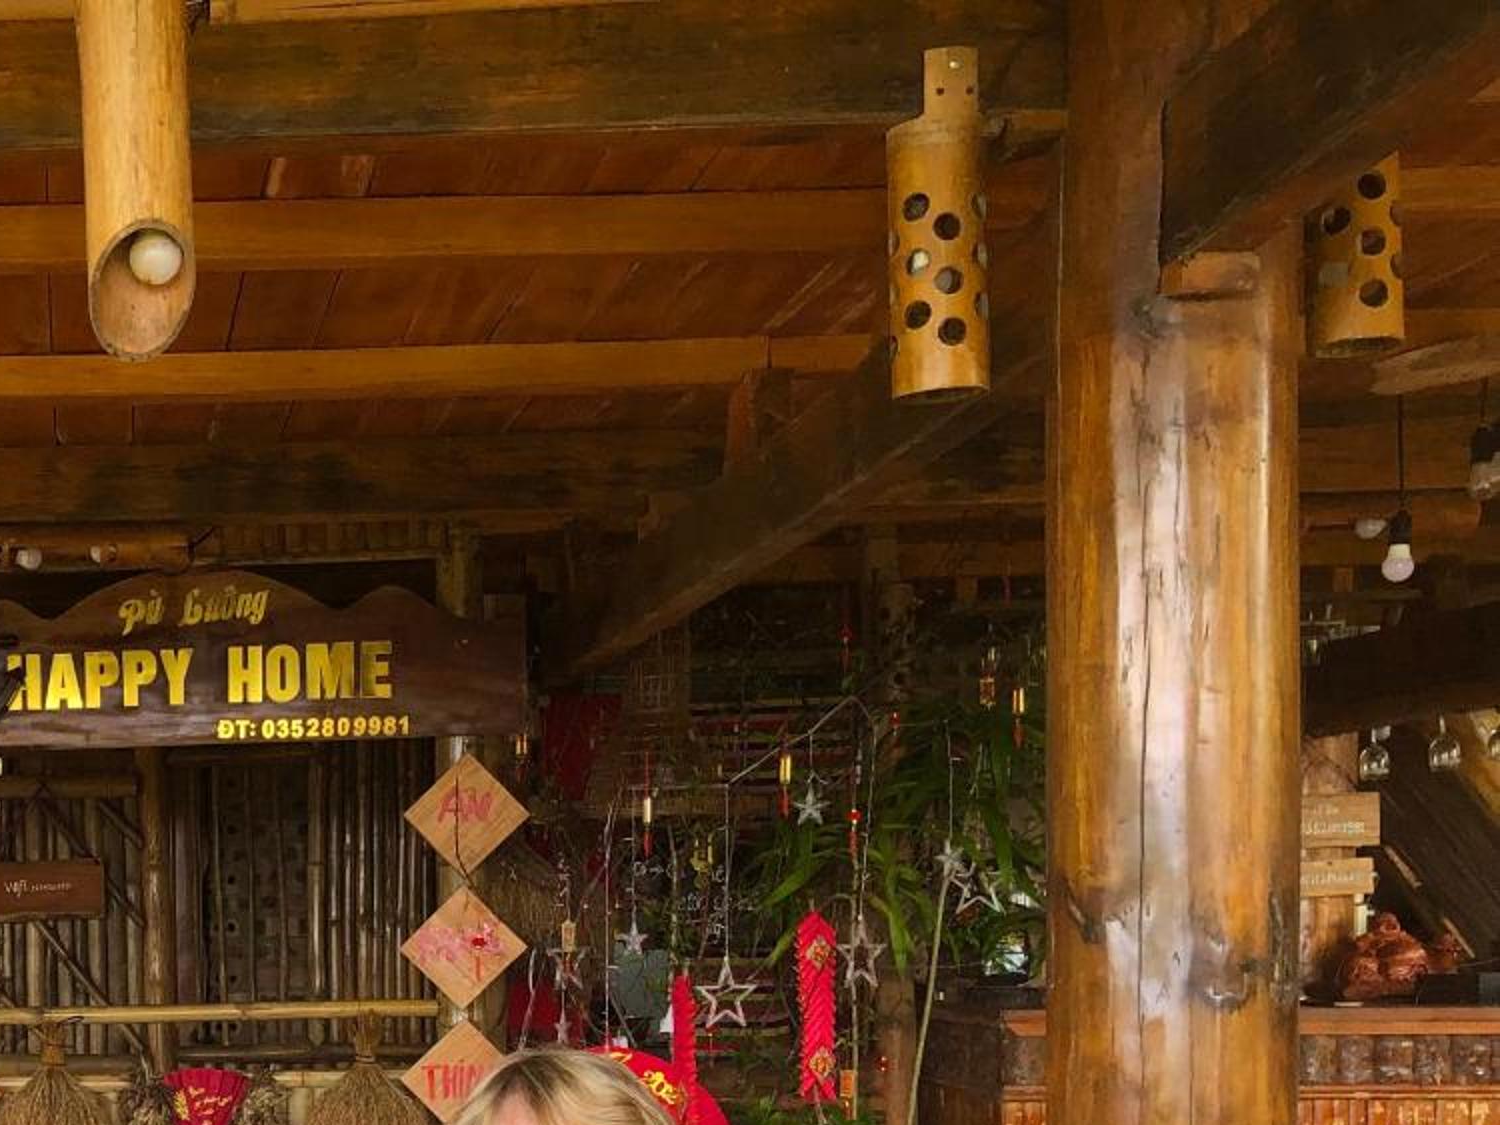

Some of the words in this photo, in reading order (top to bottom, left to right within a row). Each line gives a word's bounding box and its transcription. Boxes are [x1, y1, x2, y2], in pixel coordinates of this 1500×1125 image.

[7, 647, 193, 711] HAPPY
[227, 639, 394, 703] HOME
[261, 714, 411, 740] 0352809981
